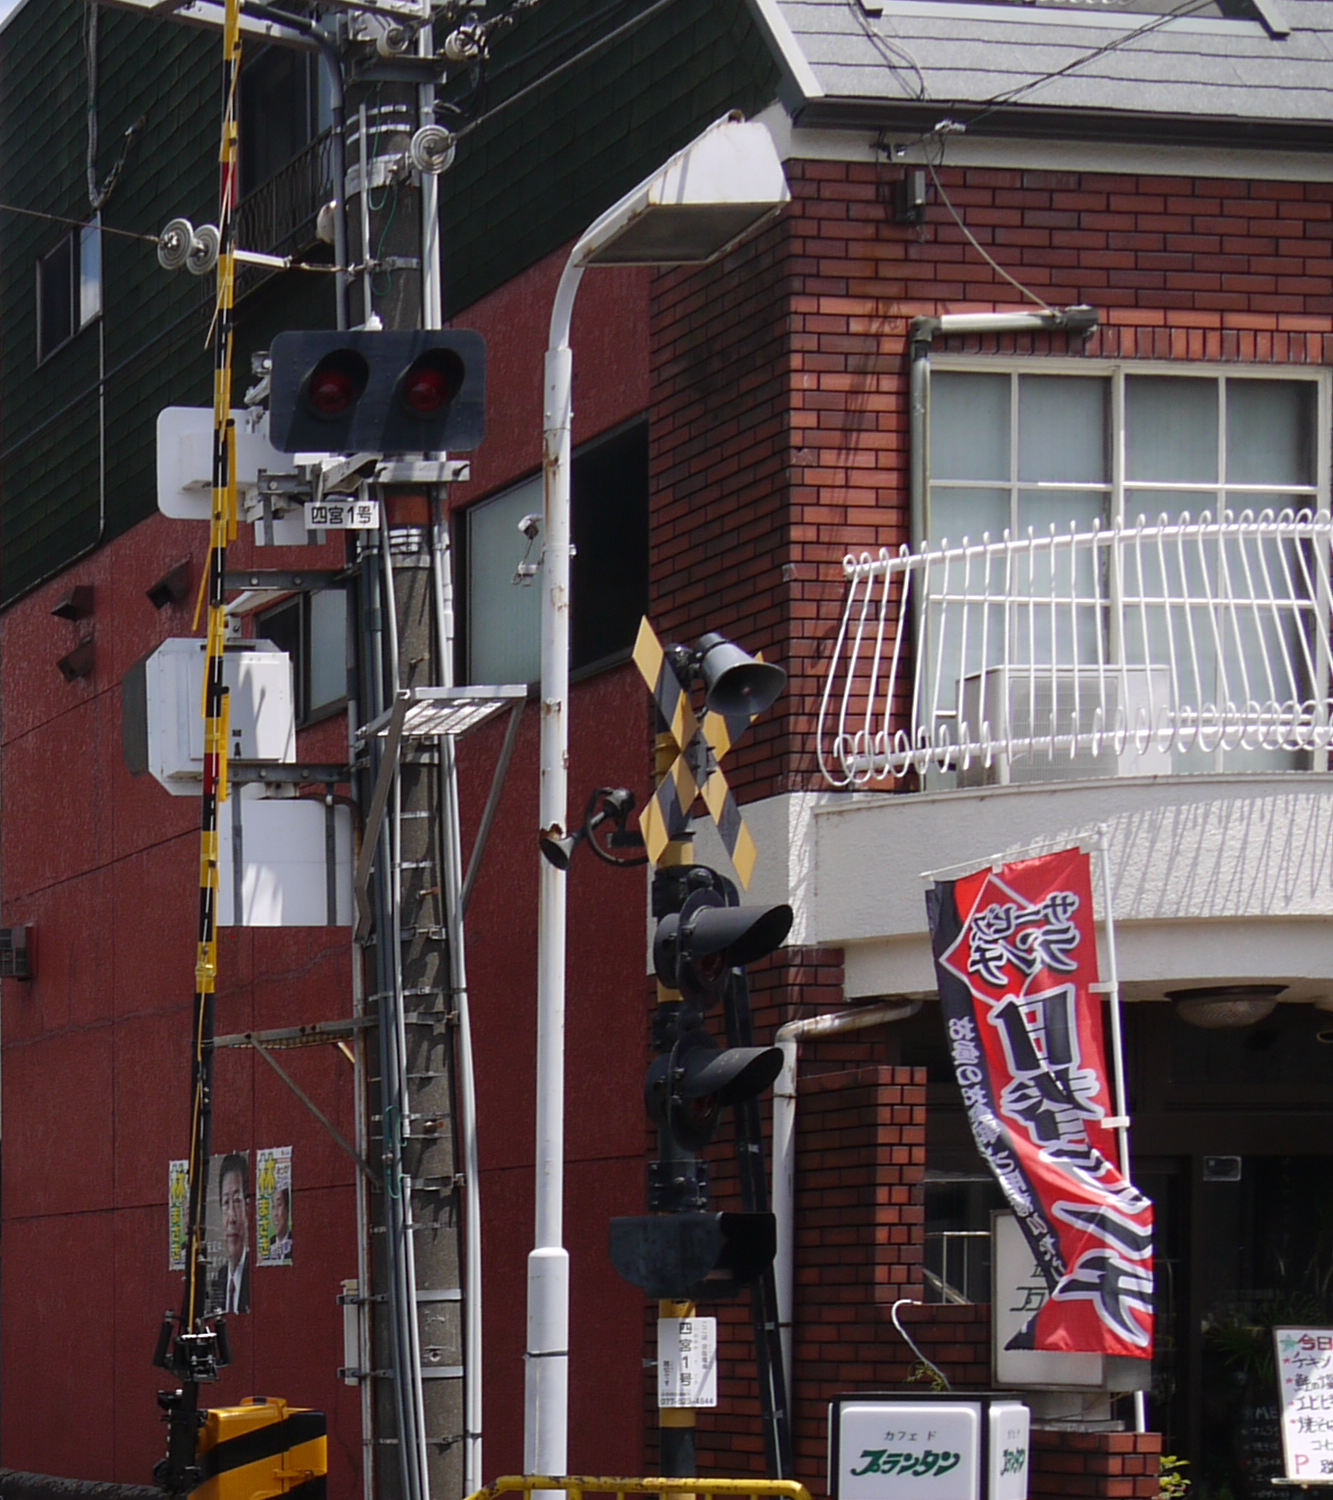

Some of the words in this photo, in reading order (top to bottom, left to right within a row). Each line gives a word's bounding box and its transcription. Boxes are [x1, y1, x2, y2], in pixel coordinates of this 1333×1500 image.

[311, 505, 372, 524] 四宮1号
[679, 1322, 693, 1386] 四宮1号
[883, 1431, 918, 1441] カフェ
[927, 1431, 937, 1441] ド
[850, 1449, 961, 1477] プランタン
[1294, 1454, 1309, 1475] P
